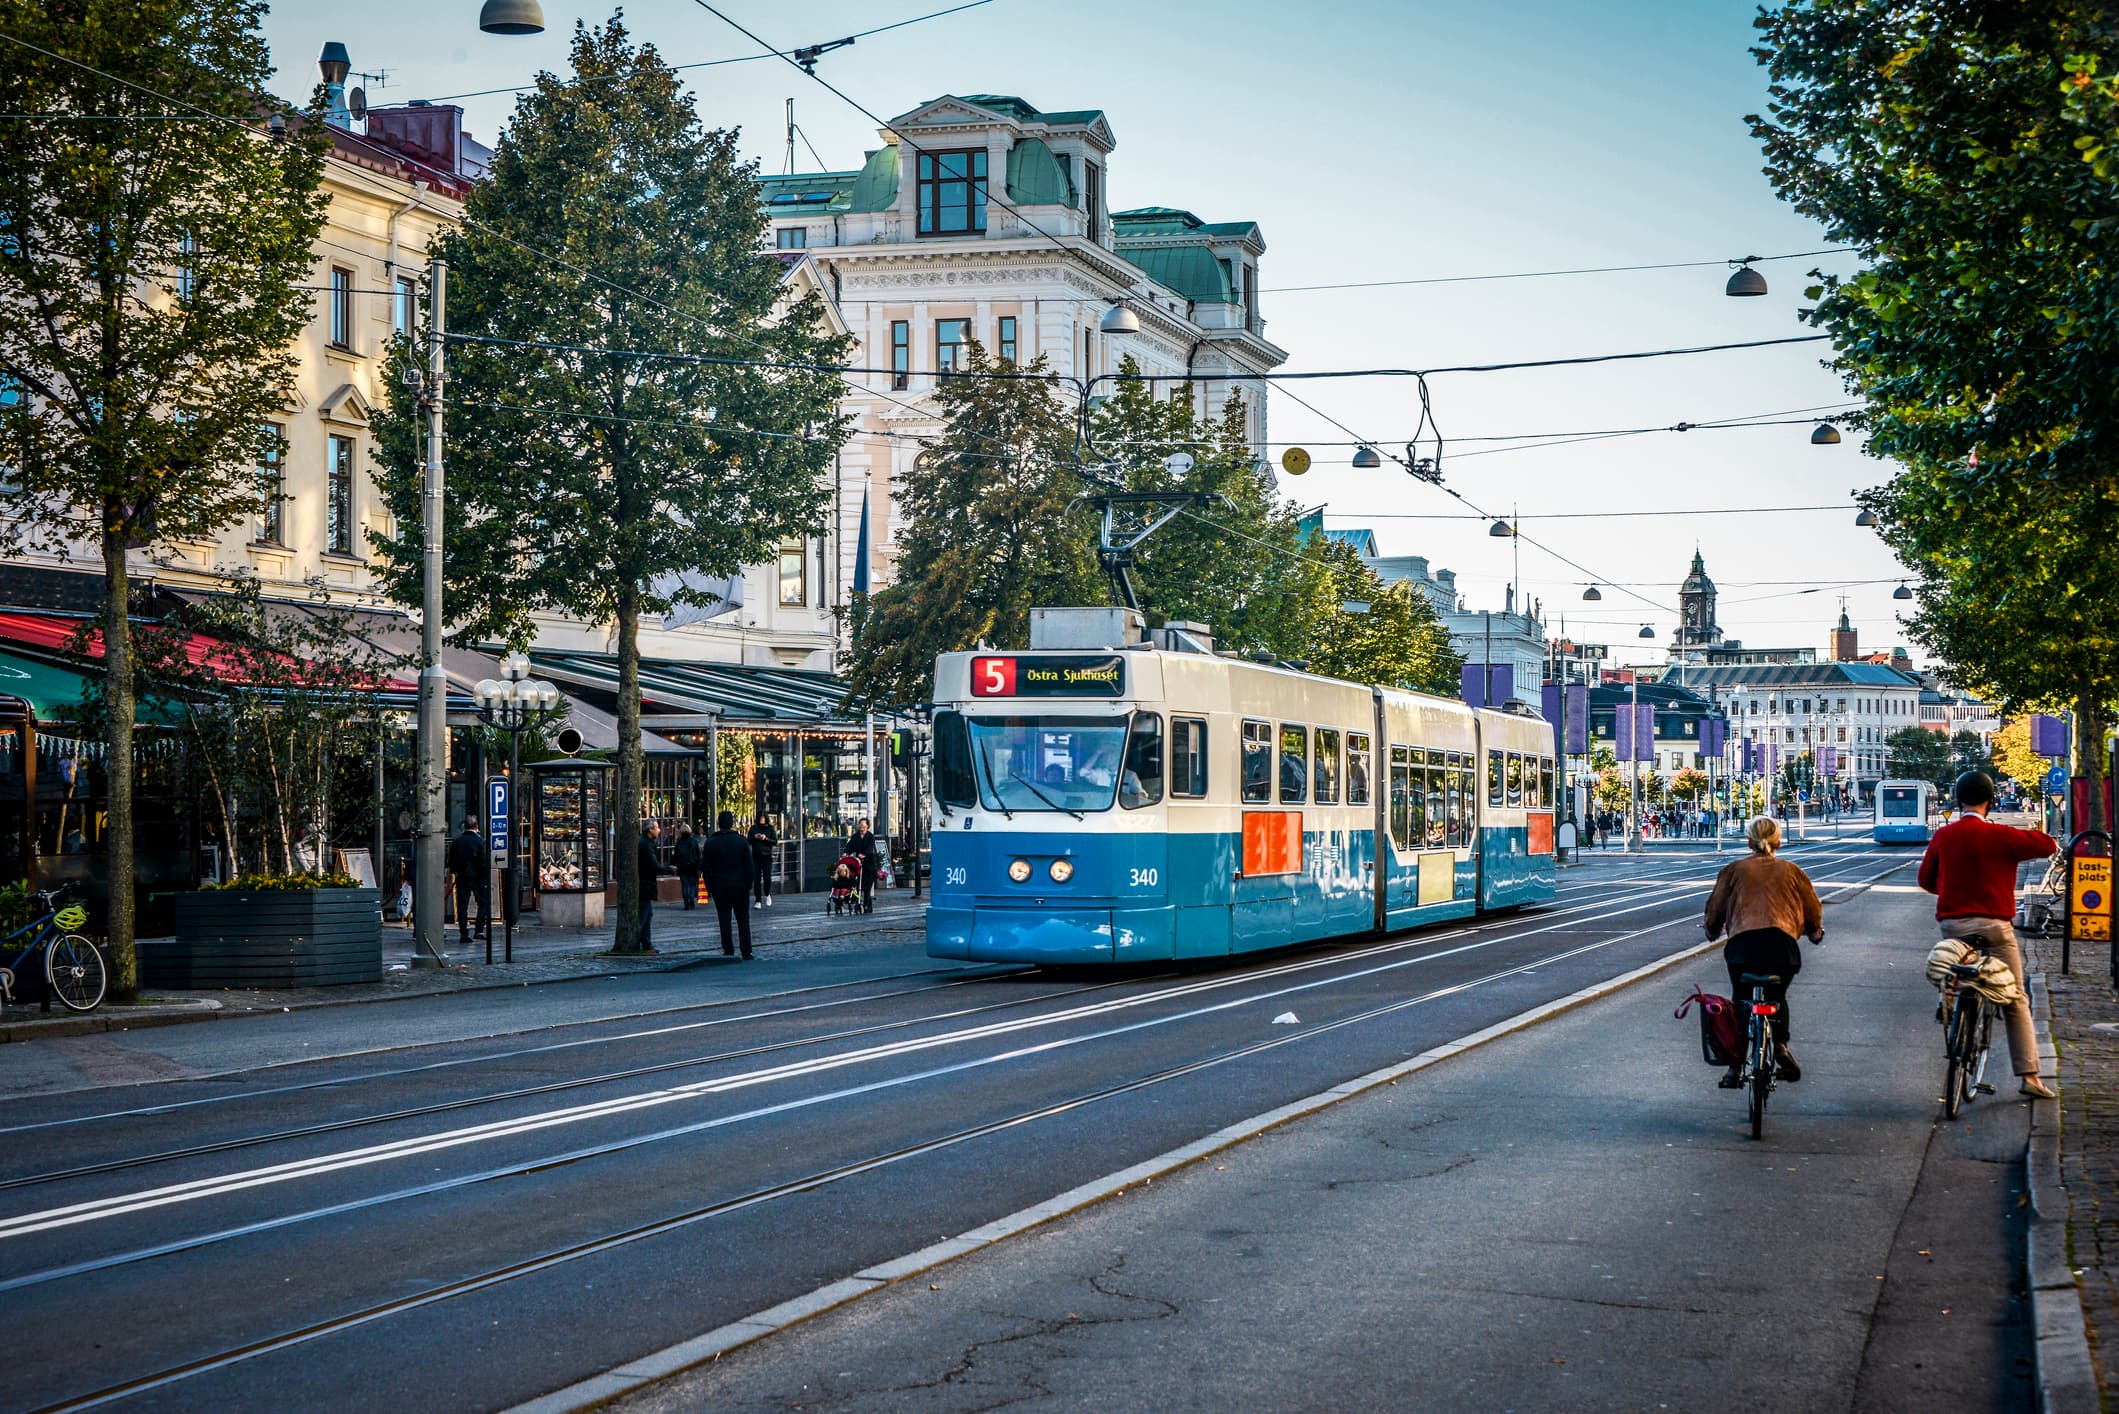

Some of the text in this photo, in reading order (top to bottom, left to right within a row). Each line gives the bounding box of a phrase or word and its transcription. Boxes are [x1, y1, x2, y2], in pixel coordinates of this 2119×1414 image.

[986, 660, 1119, 693] 5 Östra Sjukhuset
[495, 786, 505, 813] P
[2078, 862, 2108, 871] Last-
[946, 867, 966, 885] 340
[1130, 868, 1158, 887] 340
[2078, 873, 2106, 882] plats
[2080, 929, 2090, 937] 15
